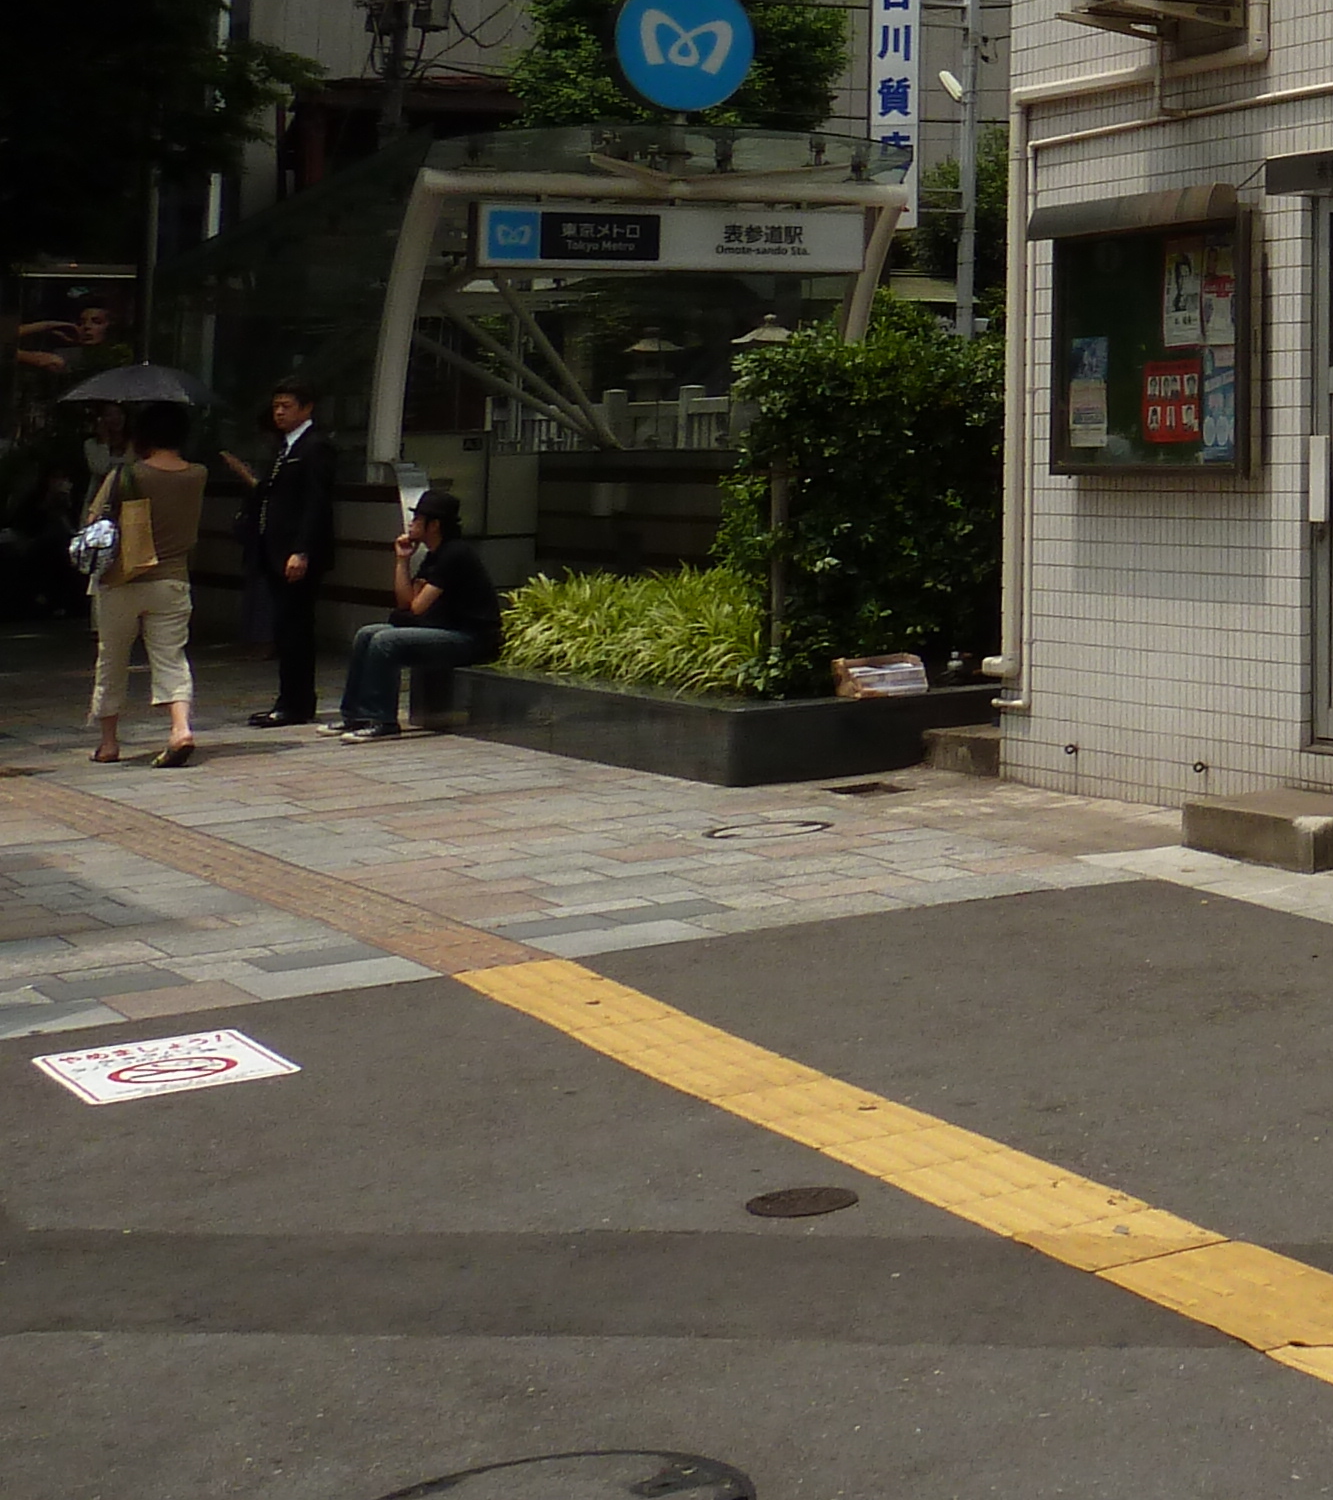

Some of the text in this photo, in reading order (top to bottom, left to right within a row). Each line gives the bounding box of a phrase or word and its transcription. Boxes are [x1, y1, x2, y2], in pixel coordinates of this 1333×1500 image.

[560, 221, 641, 240] 東京メトロ
[723, 223, 804, 246] 表参道駅
[566, 239, 635, 254] Tokyo Metro
